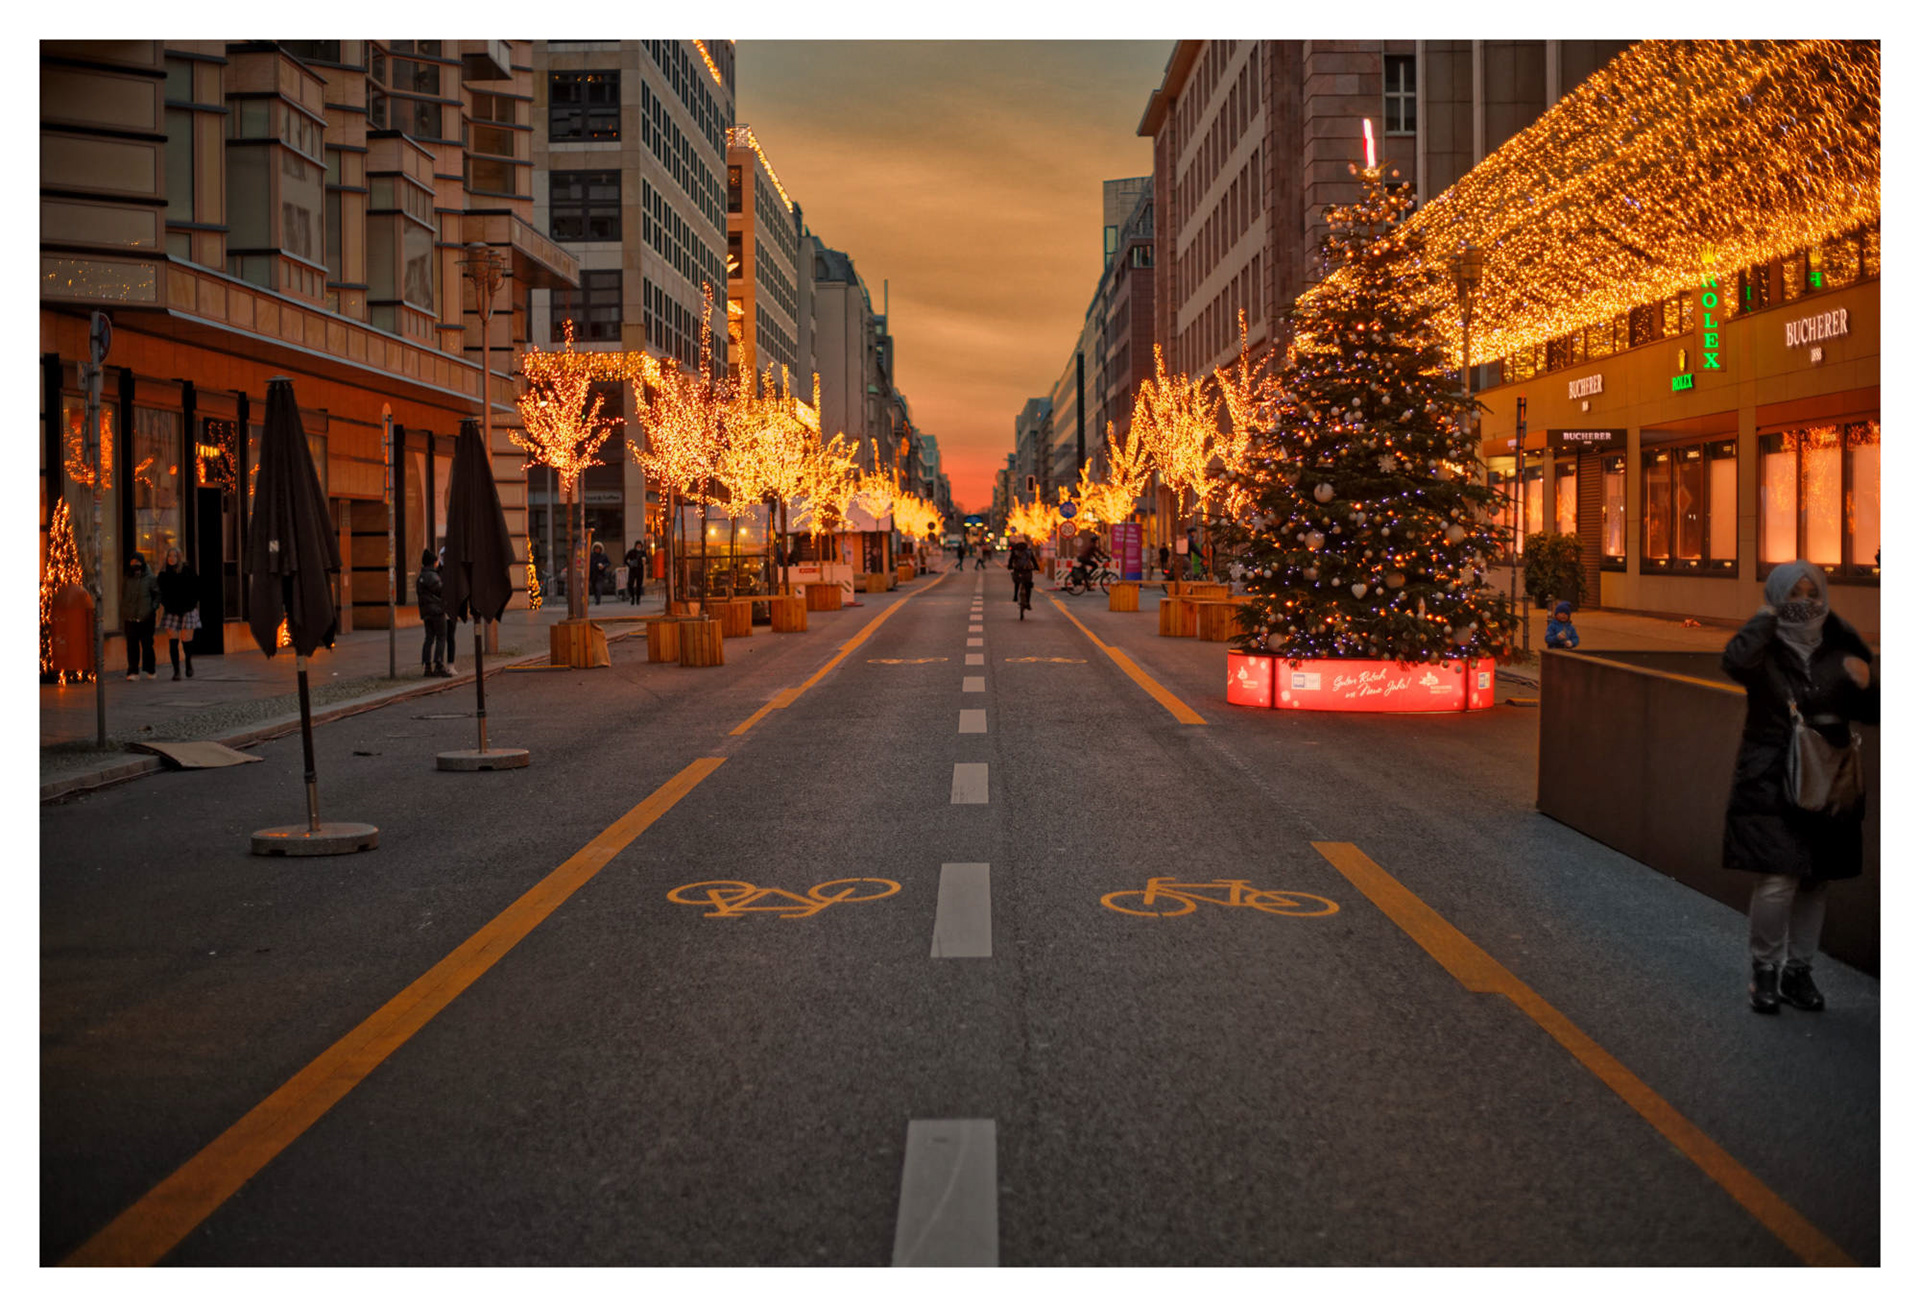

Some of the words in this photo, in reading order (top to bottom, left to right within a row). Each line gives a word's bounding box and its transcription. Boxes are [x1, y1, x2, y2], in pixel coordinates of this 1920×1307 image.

[1786, 308, 1848, 347] BUCHERER
[1568, 374, 1602, 399] BUCHERER
[1672, 373, 1693, 391] ROLEX
[1563, 432, 1611, 441] BUCHERER
[1332, 675, 1357, 692] Guten
[1358, 668, 1387, 683] Rutsch
